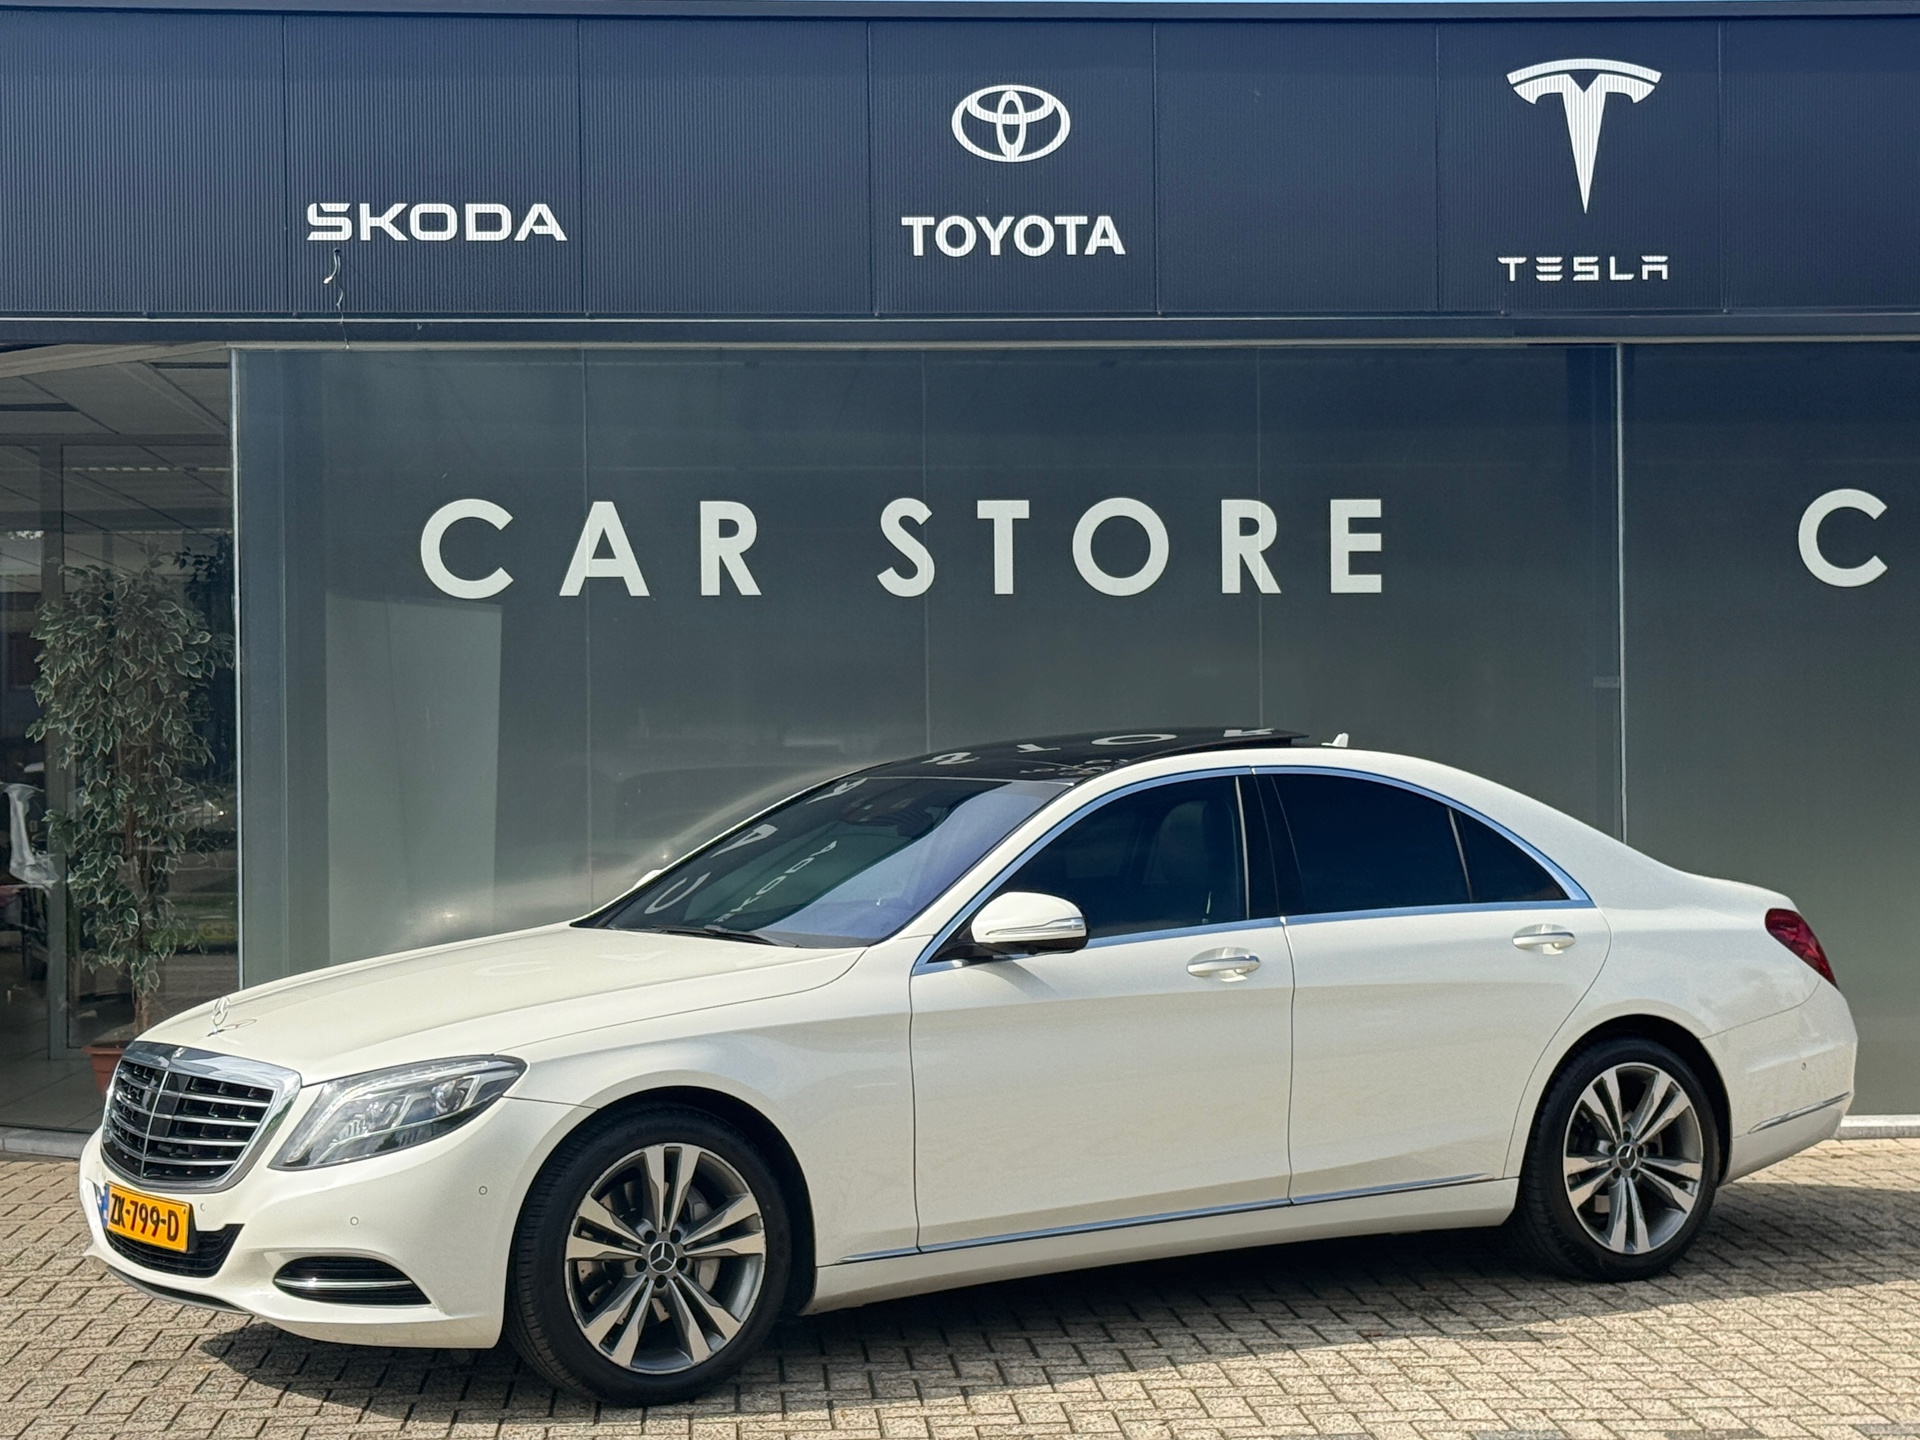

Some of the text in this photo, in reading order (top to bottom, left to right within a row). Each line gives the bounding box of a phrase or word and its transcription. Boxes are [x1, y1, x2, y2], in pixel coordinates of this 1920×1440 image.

[306, 202, 568, 242] SKODA
[901, 214, 1126, 258] TOYOTA
[1497, 255, 1669, 282] TESLA
[420, 497, 1382, 599] CAR STORE
[1798, 488, 1888, 587] C
[110, 1192, 180, 1243] ZK-799-D
